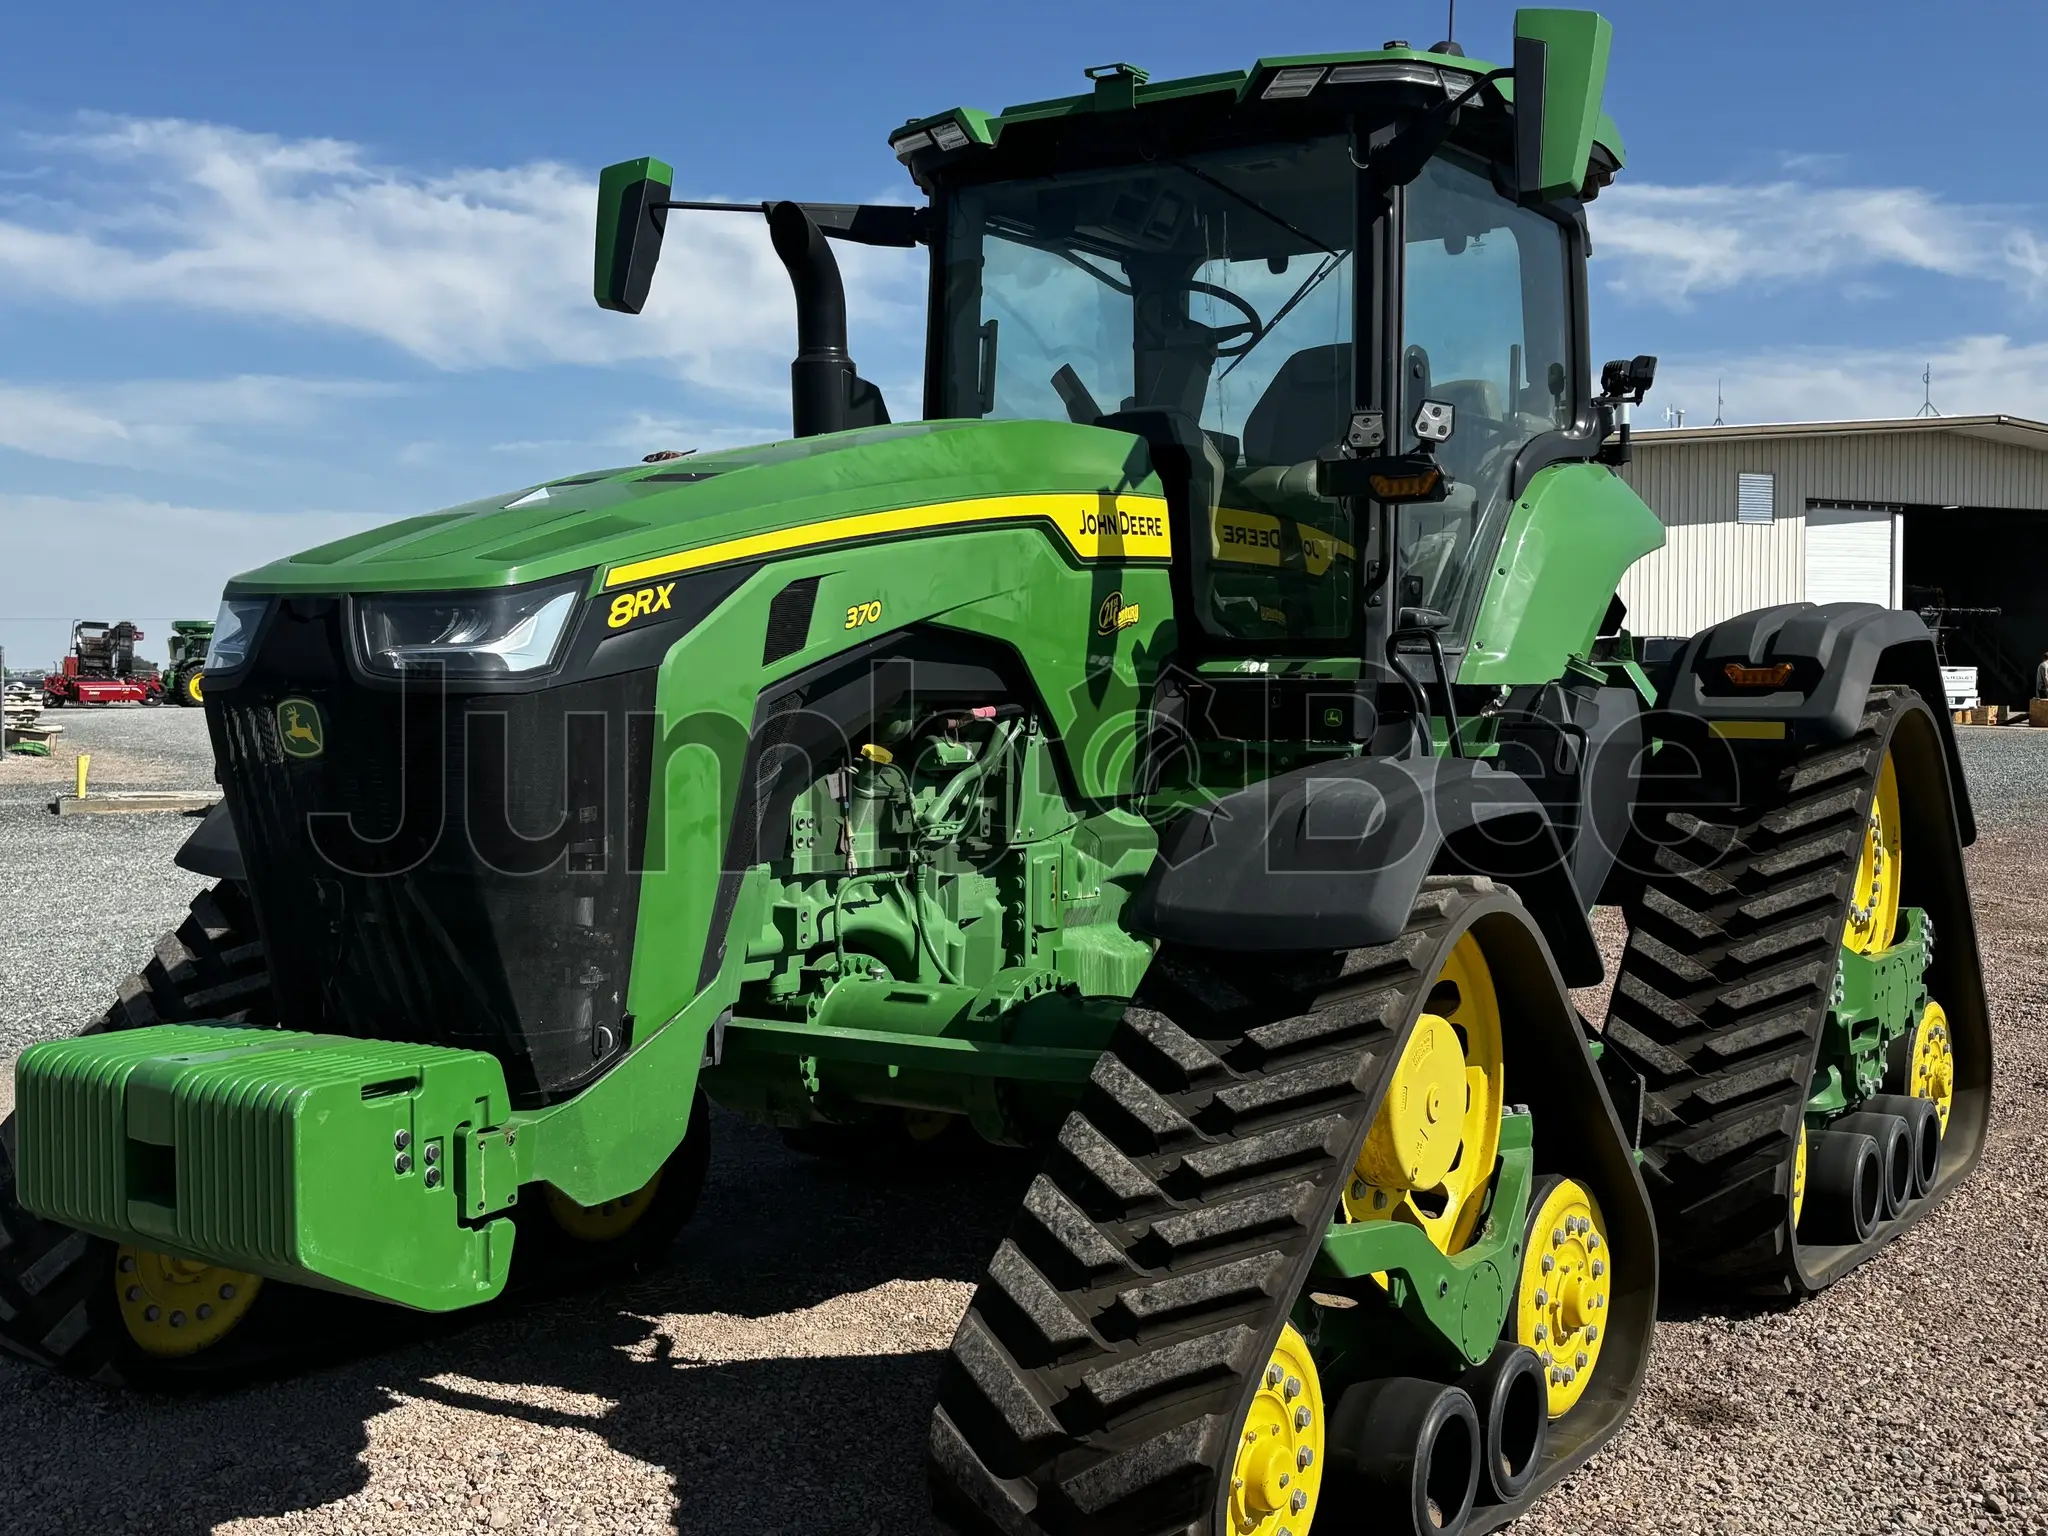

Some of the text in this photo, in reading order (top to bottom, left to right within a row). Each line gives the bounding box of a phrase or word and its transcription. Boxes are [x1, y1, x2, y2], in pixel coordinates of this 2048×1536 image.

[1079, 509, 1164, 537] JOHN DEERE
[607, 582, 676, 628] 8RX
[844, 599, 882, 630] 370
